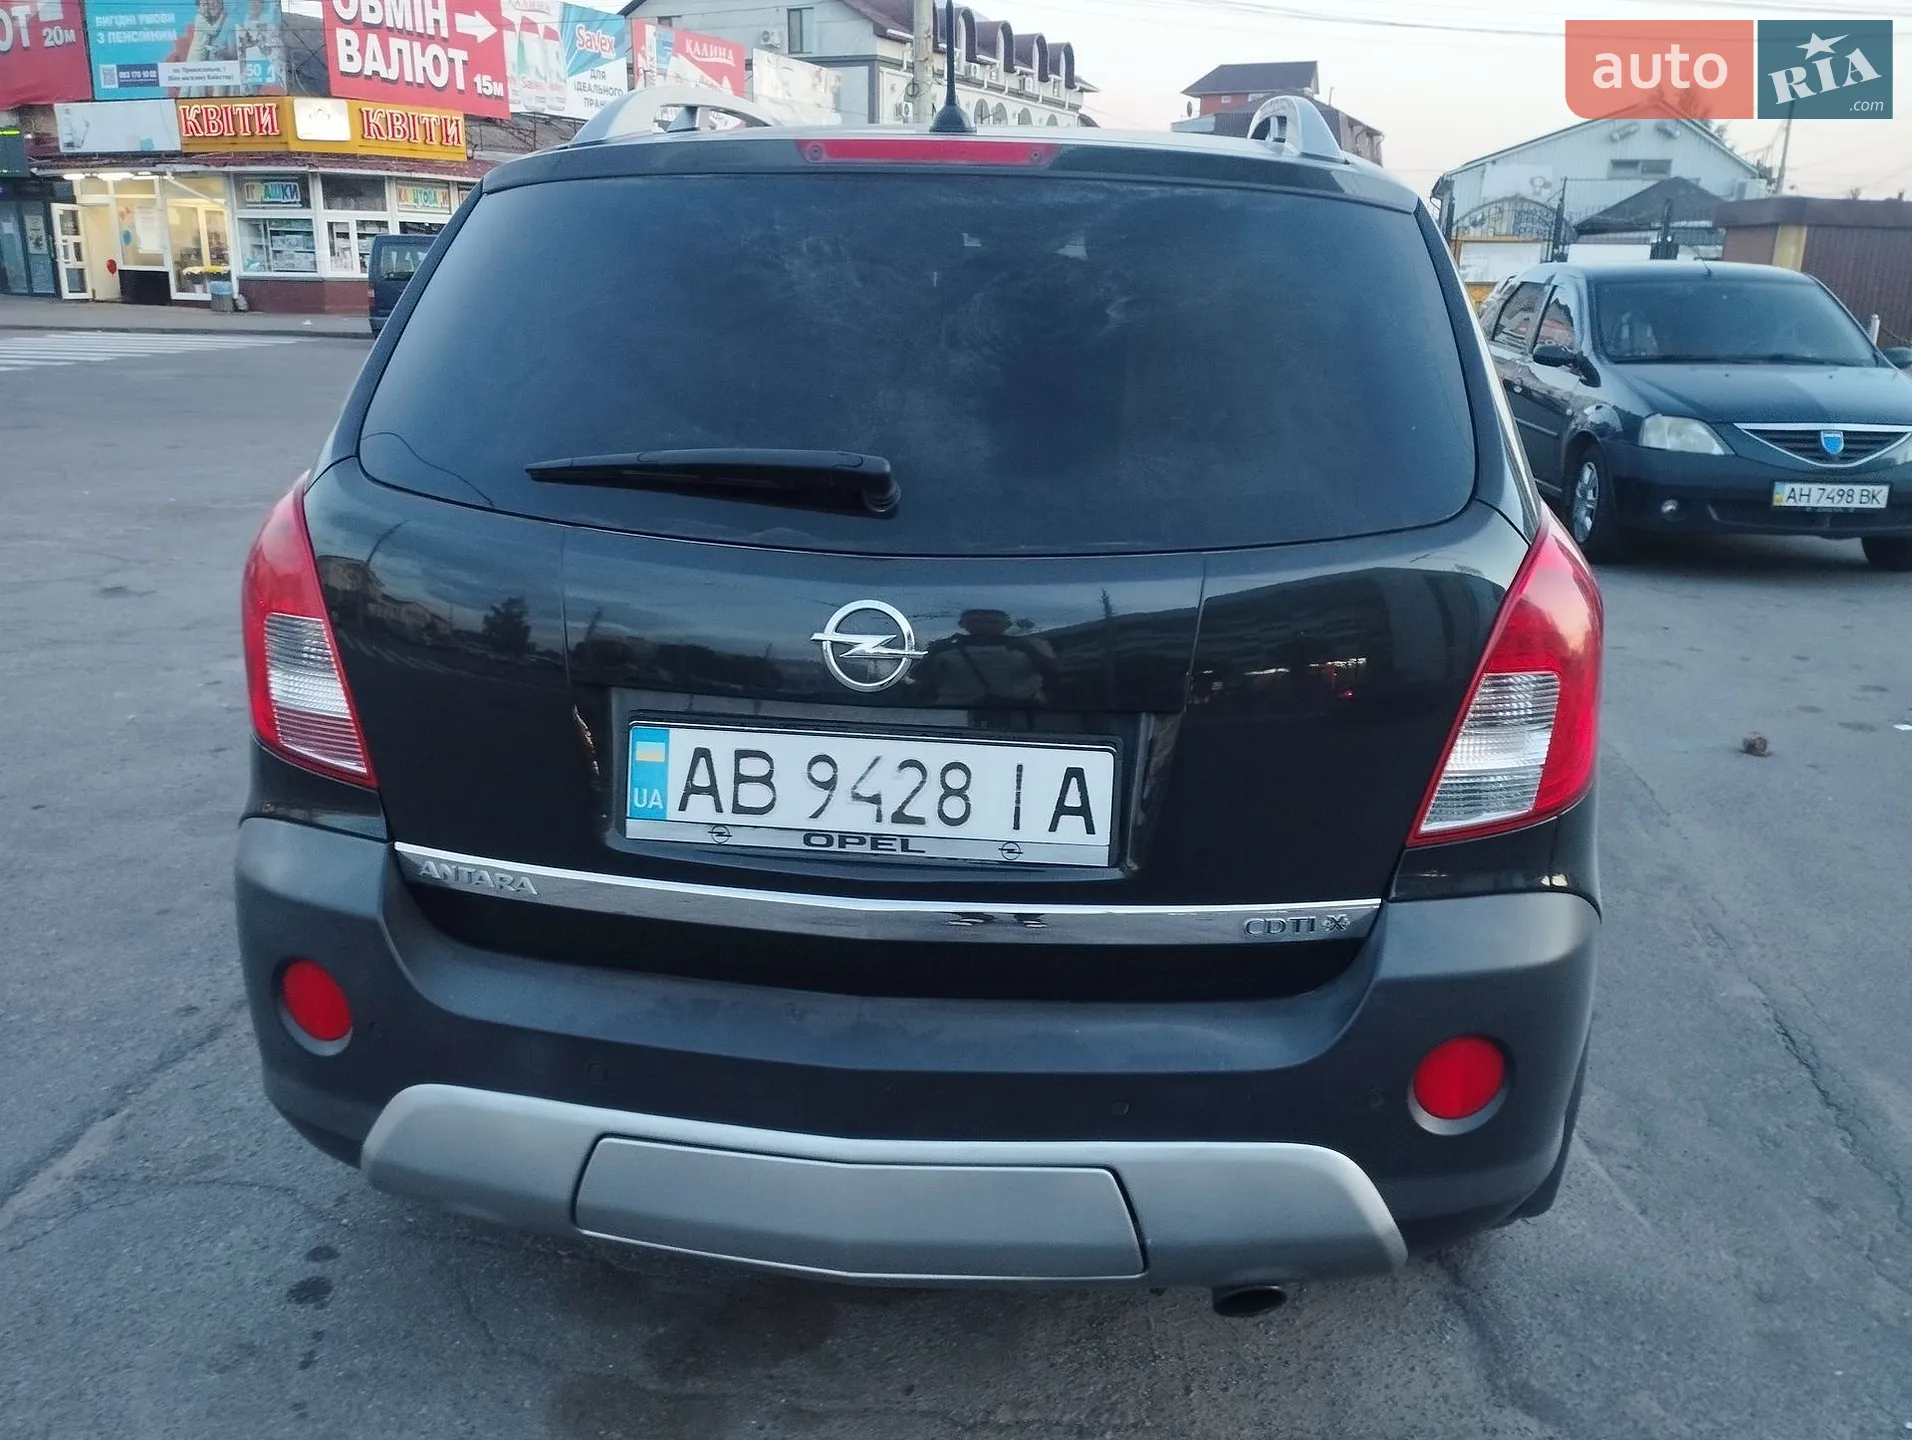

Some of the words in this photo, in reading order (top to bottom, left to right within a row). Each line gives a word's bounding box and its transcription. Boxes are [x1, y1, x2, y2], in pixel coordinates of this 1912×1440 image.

[576, 24, 615, 57] Savex
[685, 38, 735, 61] КАЛИНА
[336, 28, 469, 91] ВАЛЮТ
[590, 69, 606, 80] ДЛЯ
[573, 82, 624, 97] ІДЕАЛЬНОГО
[179, 103, 280, 137] КВІТИ
[361, 107, 465, 146] КВІТИ
[1786, 487, 1812, 504] AH
[1816, 487, 1855, 504] 7498
[1859, 488, 1883, 505] BK
[678, 746, 777, 816] AB
[805, 753, 972, 827] 9428
[632, 788, 664, 810] UA
[803, 832, 926, 854] OPEL
[418, 860, 538, 895] ANTARA
[1243, 915, 1317, 935] CDTI
